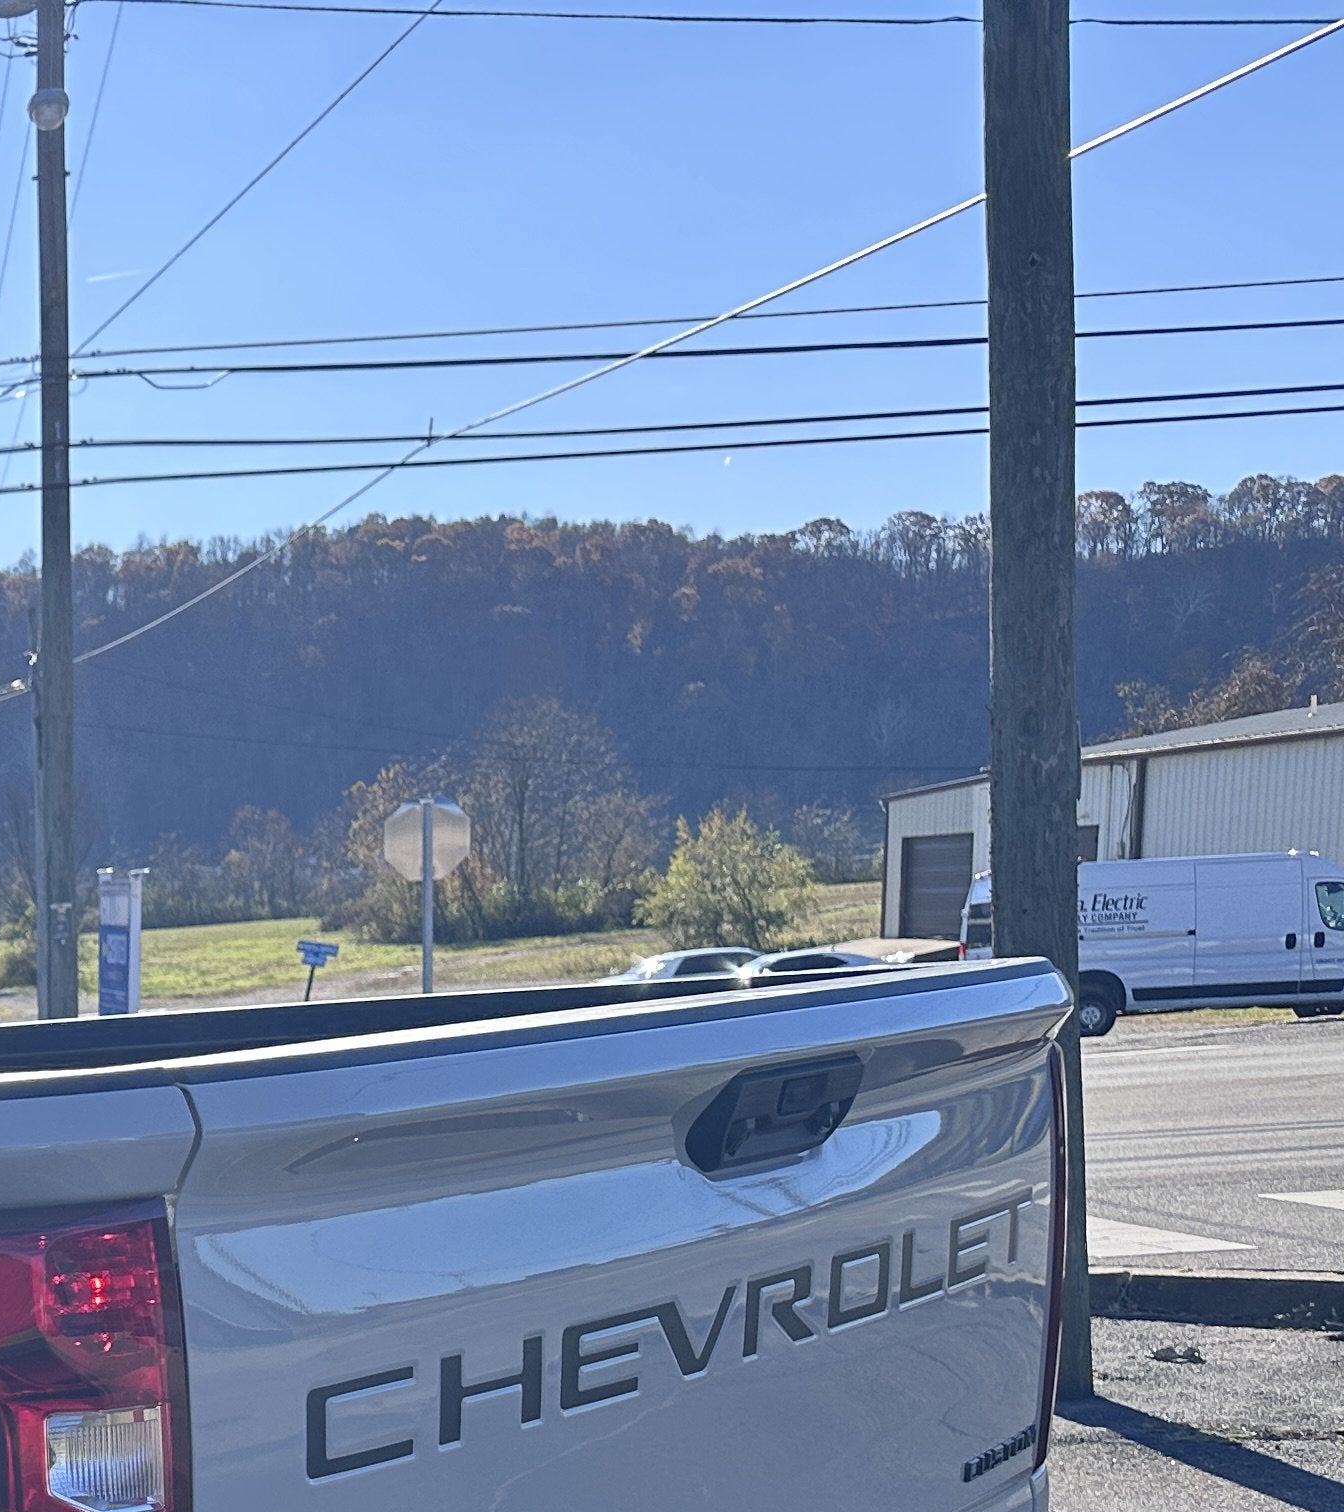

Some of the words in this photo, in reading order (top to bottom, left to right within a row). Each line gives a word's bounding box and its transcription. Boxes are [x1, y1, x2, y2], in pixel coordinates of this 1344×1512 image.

[1092, 893, 1149, 912] Electric
[1091, 911, 1138, 922] COMPANY
[307, 1187, 1033, 1482] CHEVROLET
